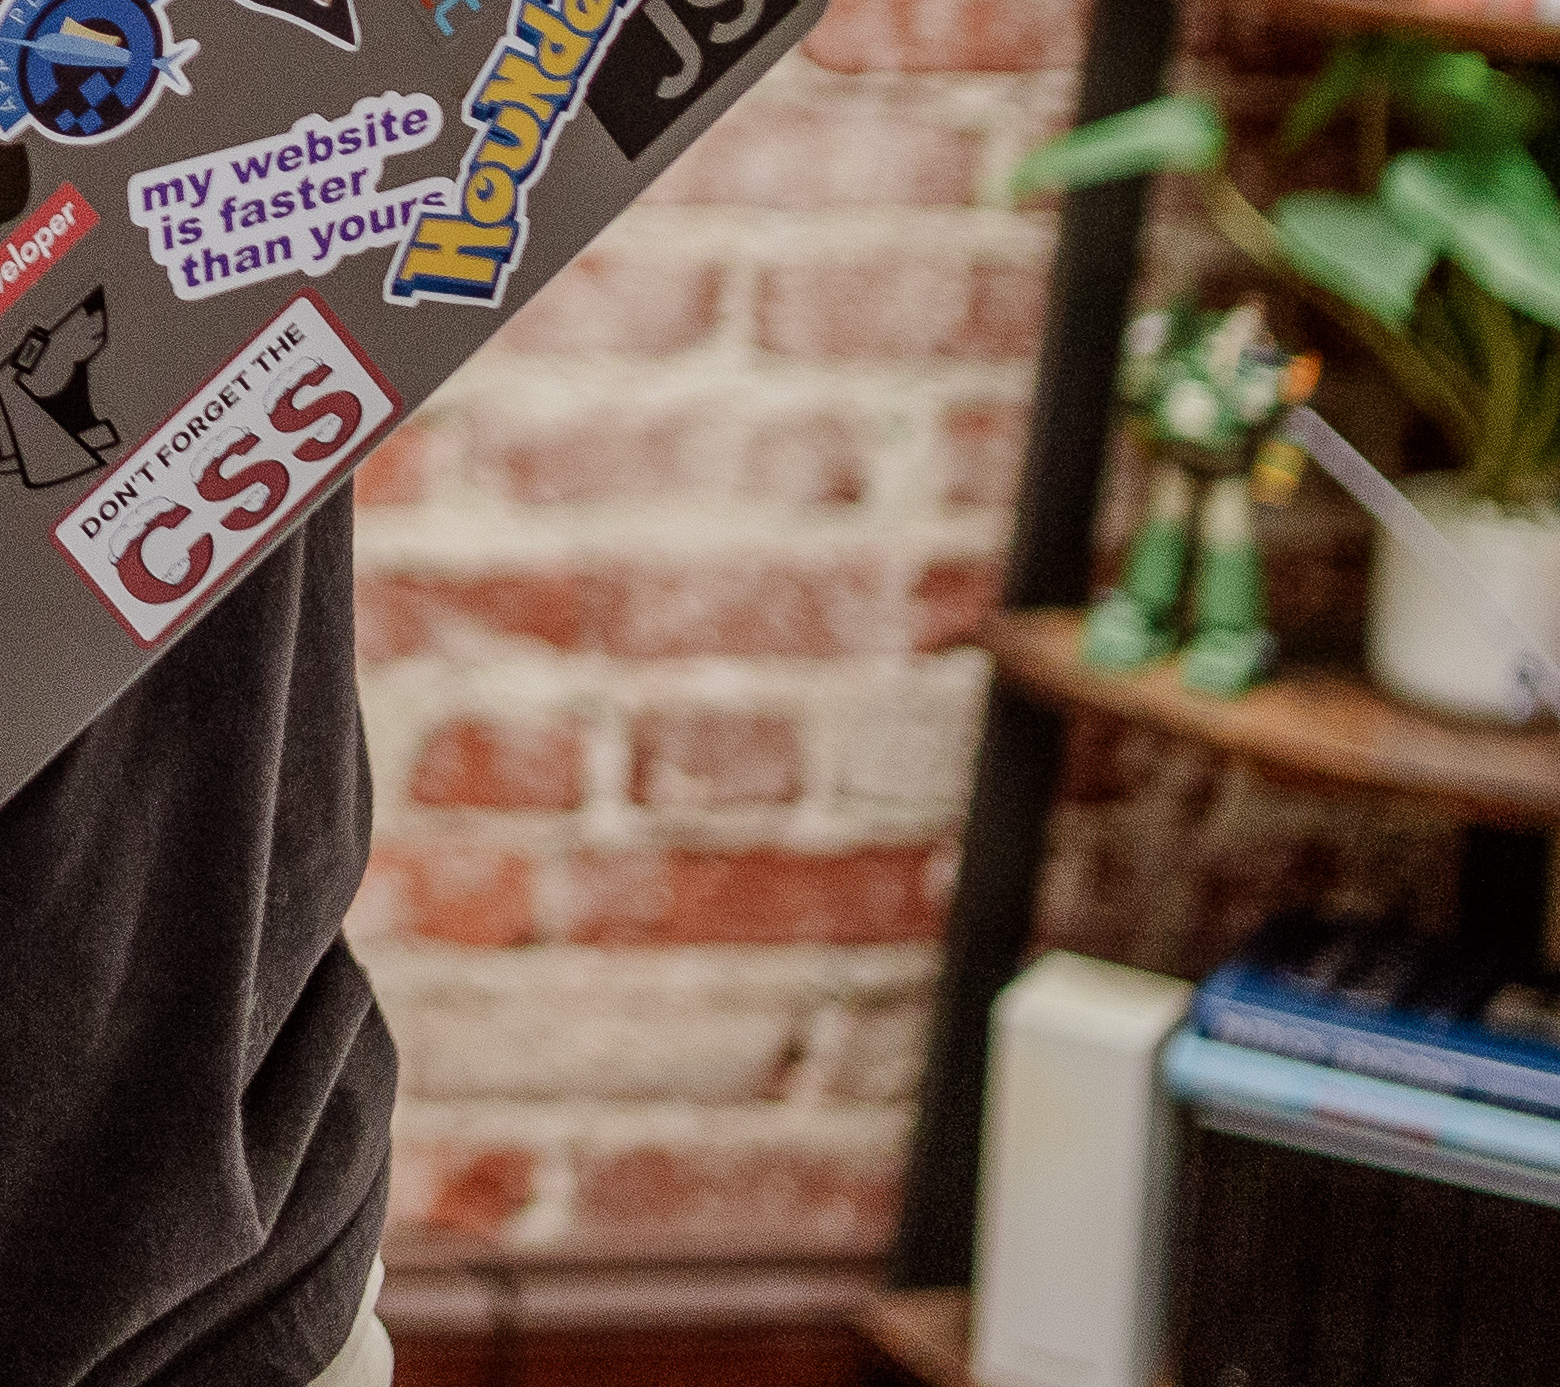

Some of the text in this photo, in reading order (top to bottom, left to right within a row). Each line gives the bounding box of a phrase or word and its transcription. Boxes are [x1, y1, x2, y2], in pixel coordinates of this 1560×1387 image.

[141, 108, 429, 211] my website
[161, 168, 370, 249] is faster
[180, 191, 447, 287] than yours
[79, 322, 307, 539] DON'T FORGET THE
[111, 359, 363, 605] CSS
